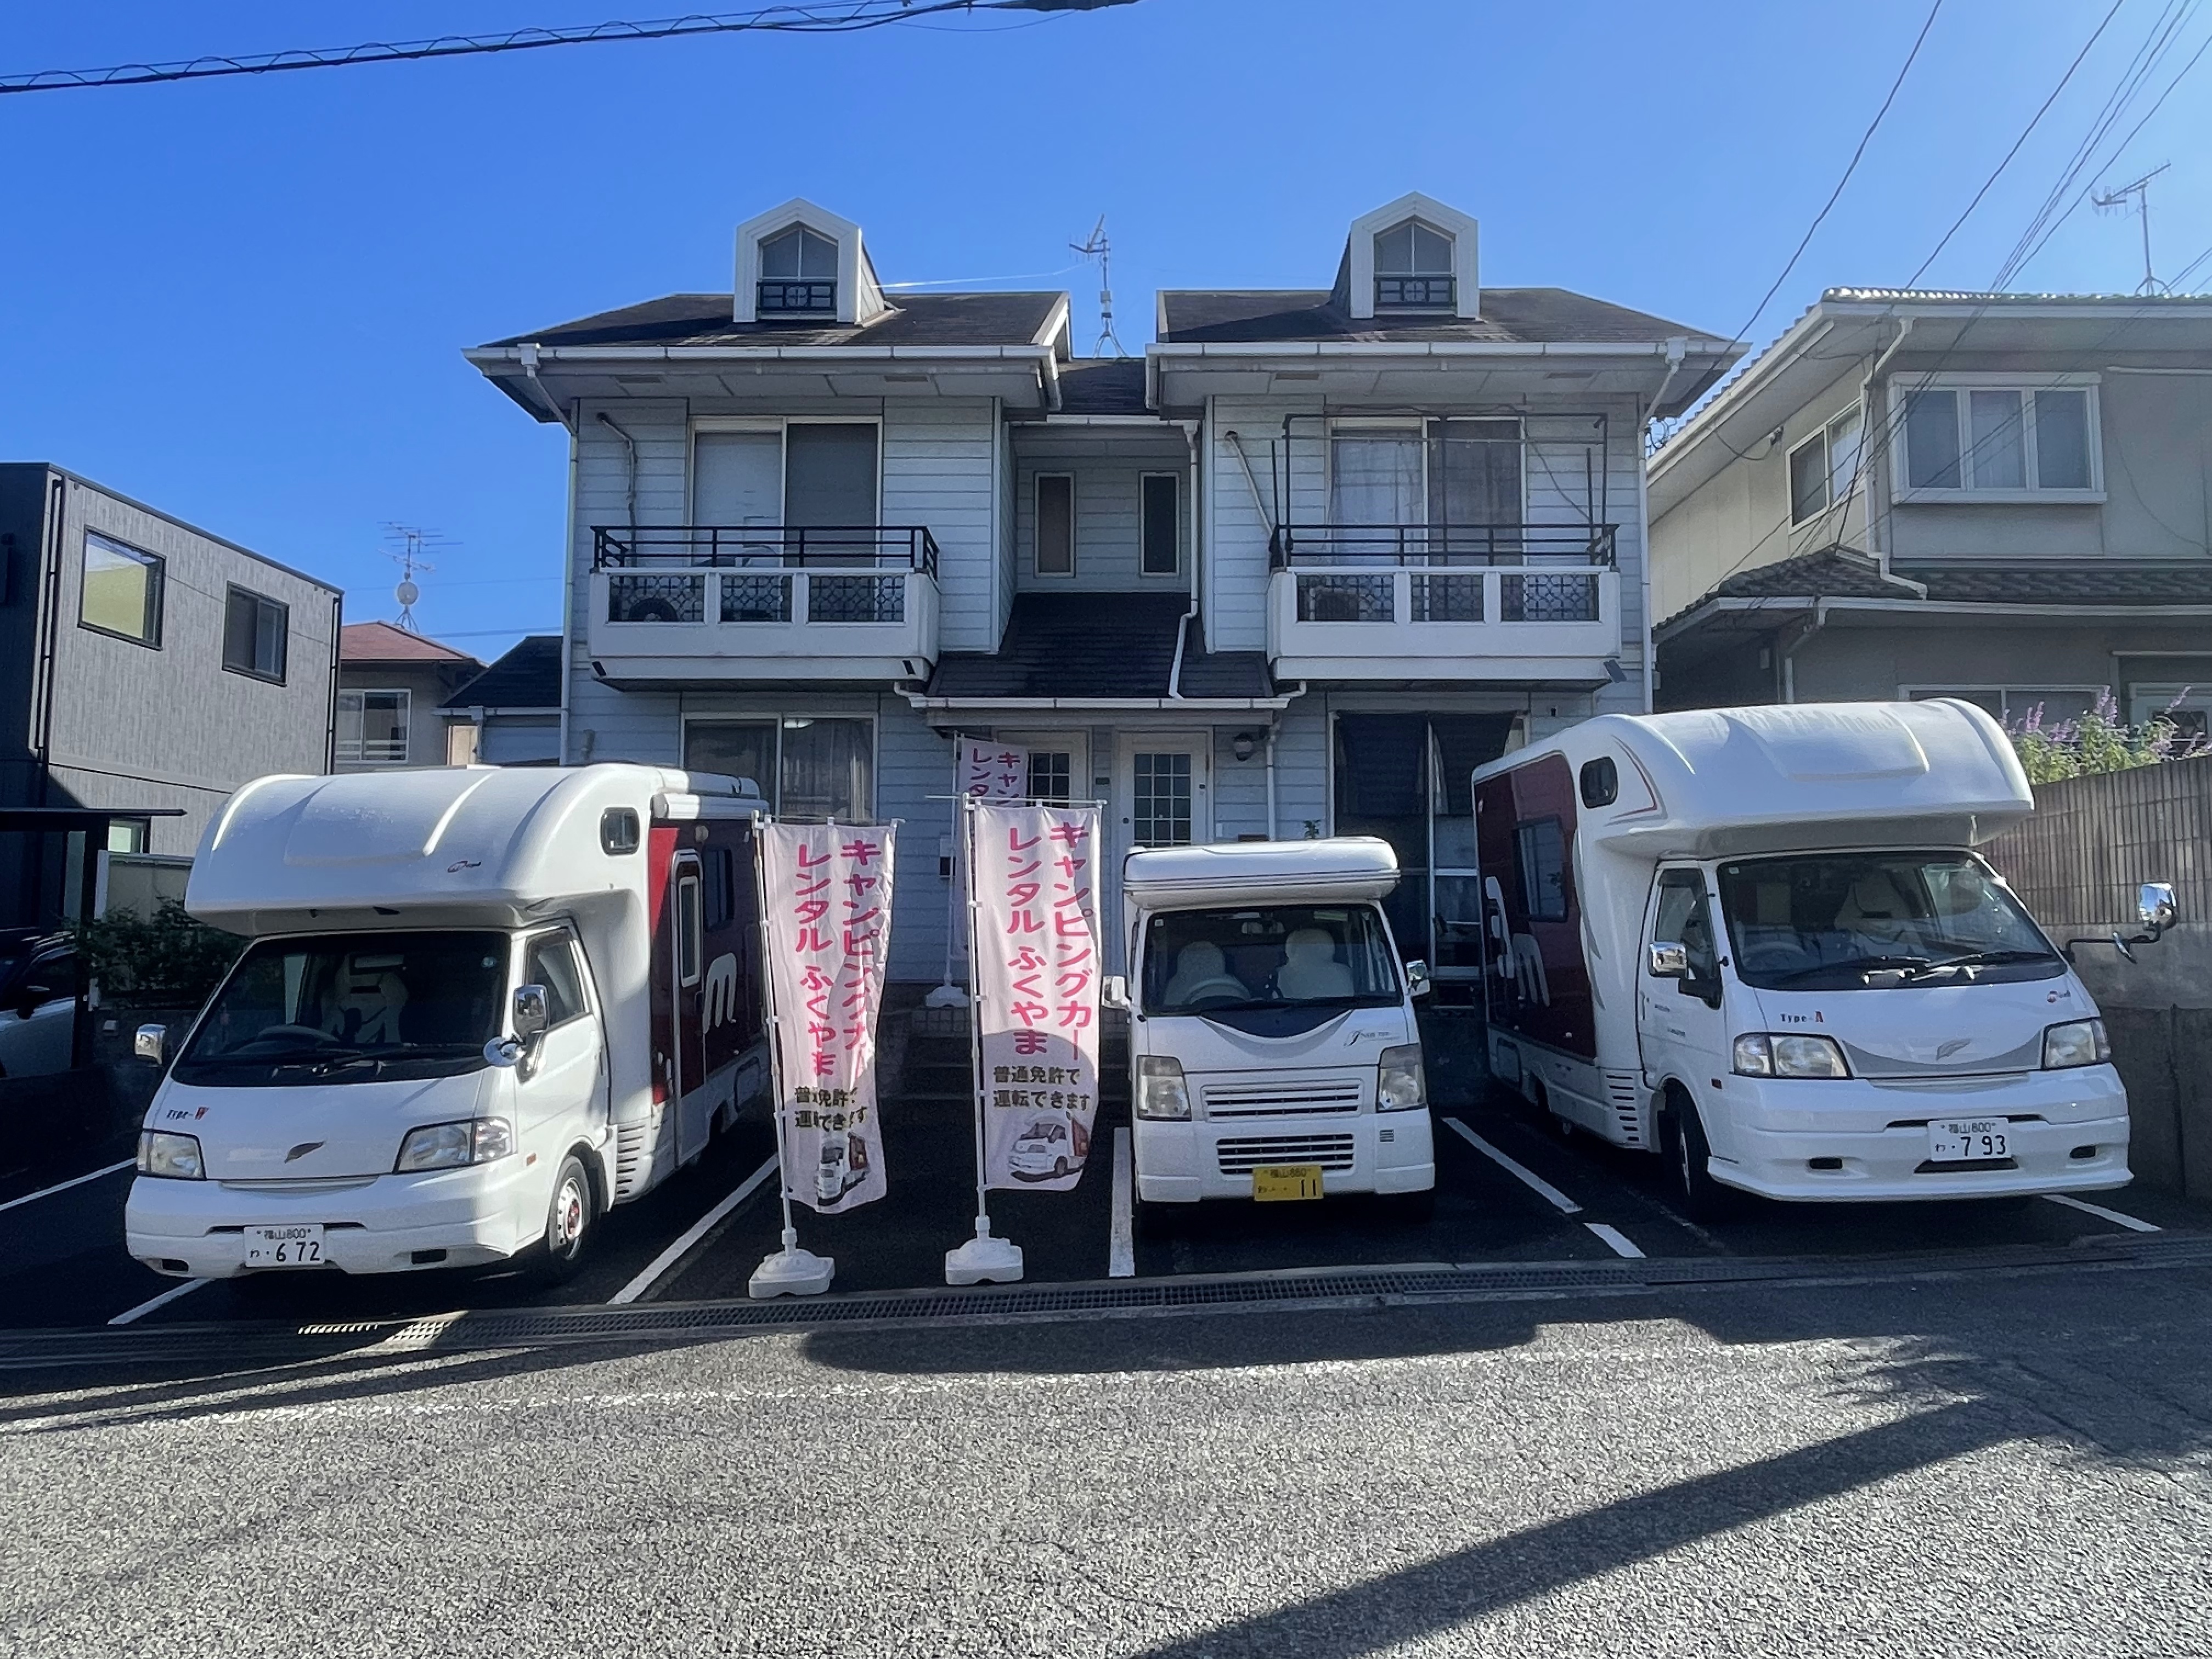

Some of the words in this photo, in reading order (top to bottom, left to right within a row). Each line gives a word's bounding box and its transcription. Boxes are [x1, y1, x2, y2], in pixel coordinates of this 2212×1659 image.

[996, 752, 1020, 804] キャン
[794, 844, 833, 952] レンタル
[1007, 828, 1045, 934] レンタル
[1050, 822, 1093, 1060] キャンピングカー
[1008, 946, 1048, 1055] ふくやま
[994, 1065, 1080, 1085] 普通免許で
[994, 1090, 1090, 1111] 運転できます
[795, 1106, 868, 1132] 運できす
